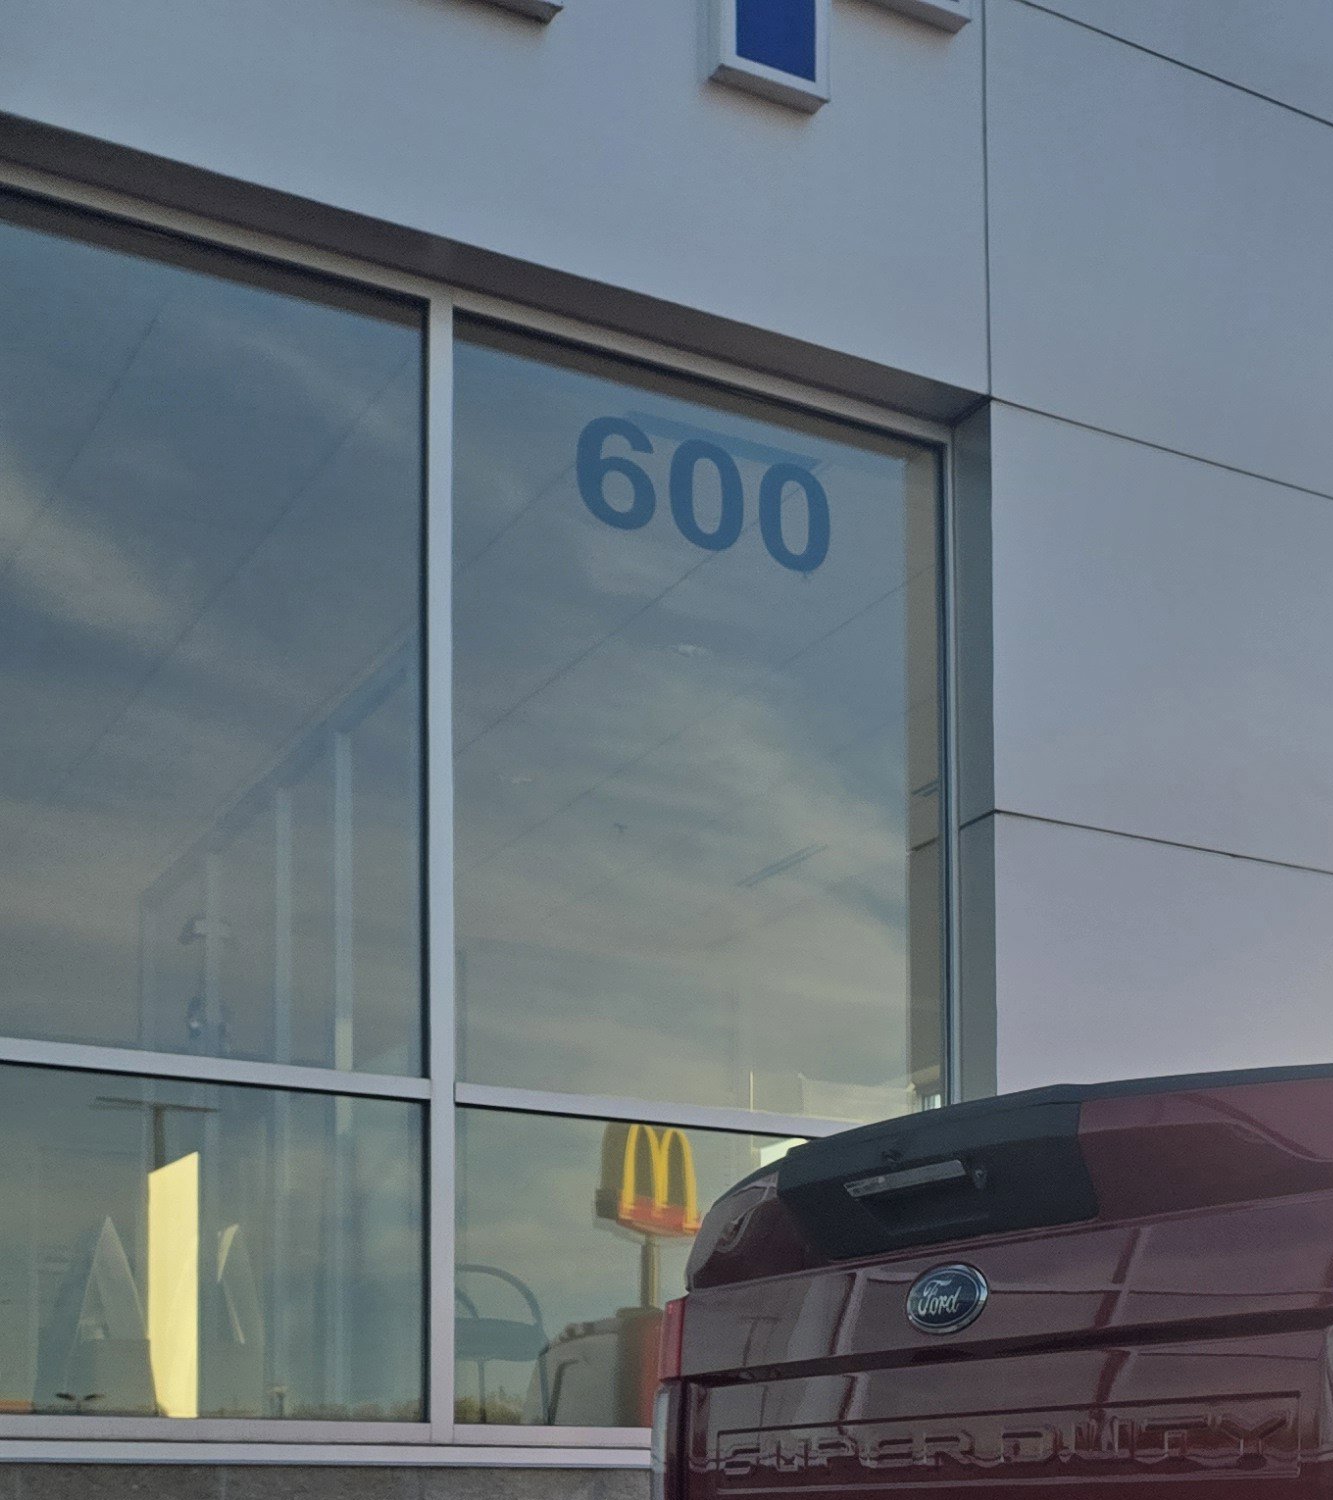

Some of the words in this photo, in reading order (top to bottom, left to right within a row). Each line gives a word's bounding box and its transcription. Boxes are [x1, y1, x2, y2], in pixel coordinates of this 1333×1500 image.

[576, 415, 831, 572] 600
[917, 1279, 962, 1316] Ford
[722, 1424, 980, 1477] SUPER
[1001, 1408, 1293, 1467] DUTY
